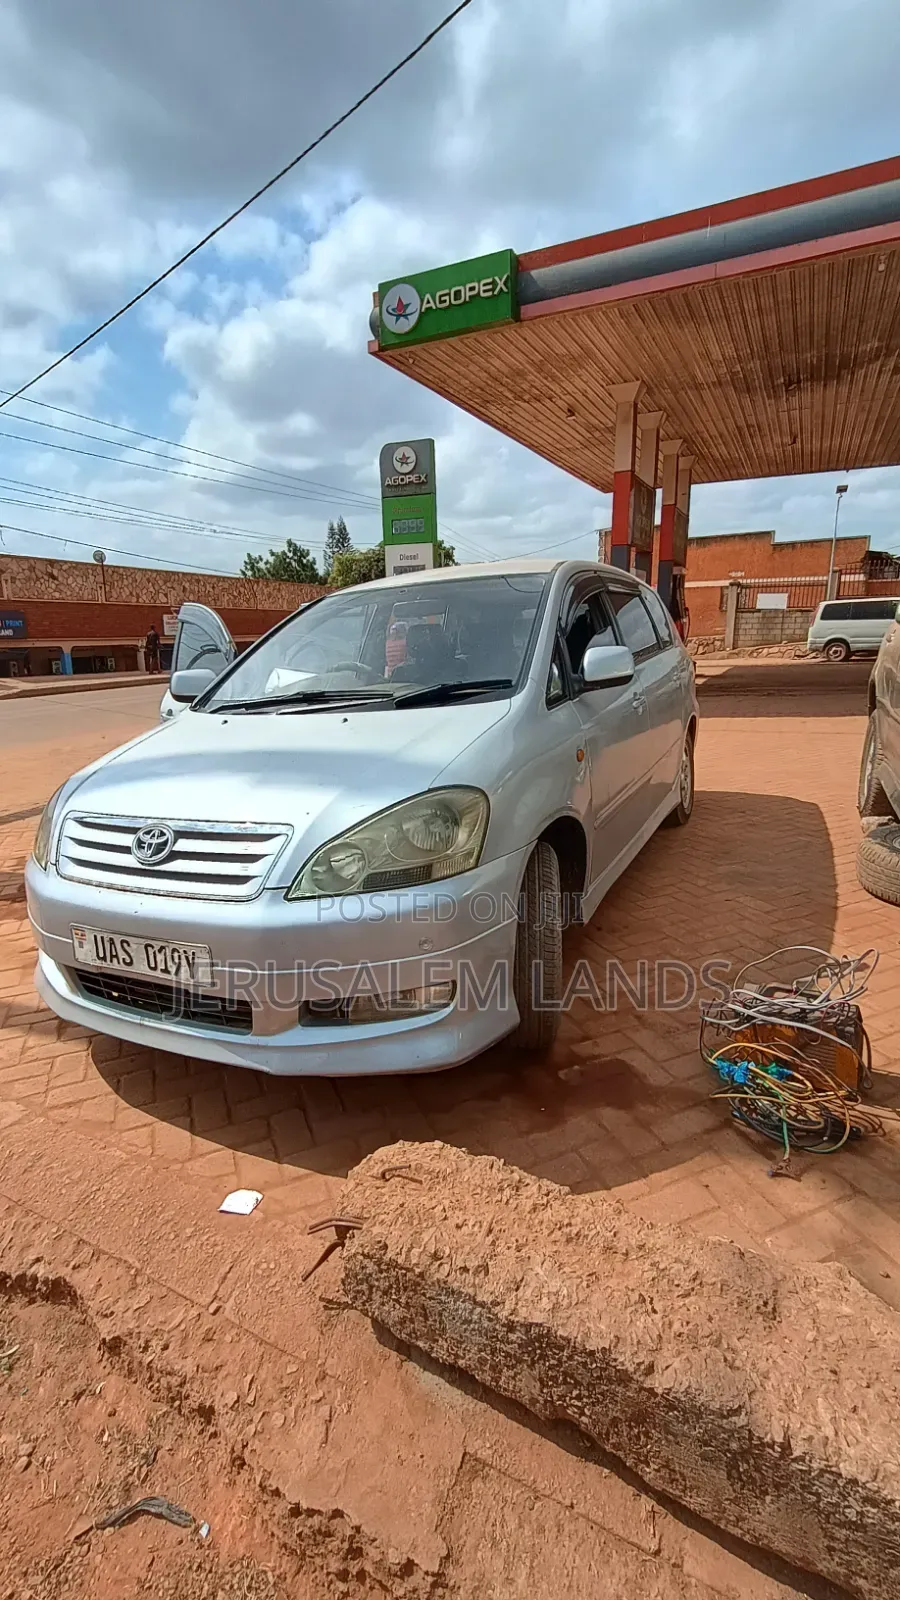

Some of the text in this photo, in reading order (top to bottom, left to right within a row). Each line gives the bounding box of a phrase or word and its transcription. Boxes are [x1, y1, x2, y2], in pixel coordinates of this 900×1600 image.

[421, 272, 509, 312] AGOPEX
[384, 473, 427, 486] AGOPEX
[399, 553, 419, 561] Diesel
[93, 933, 134, 967] UAS
